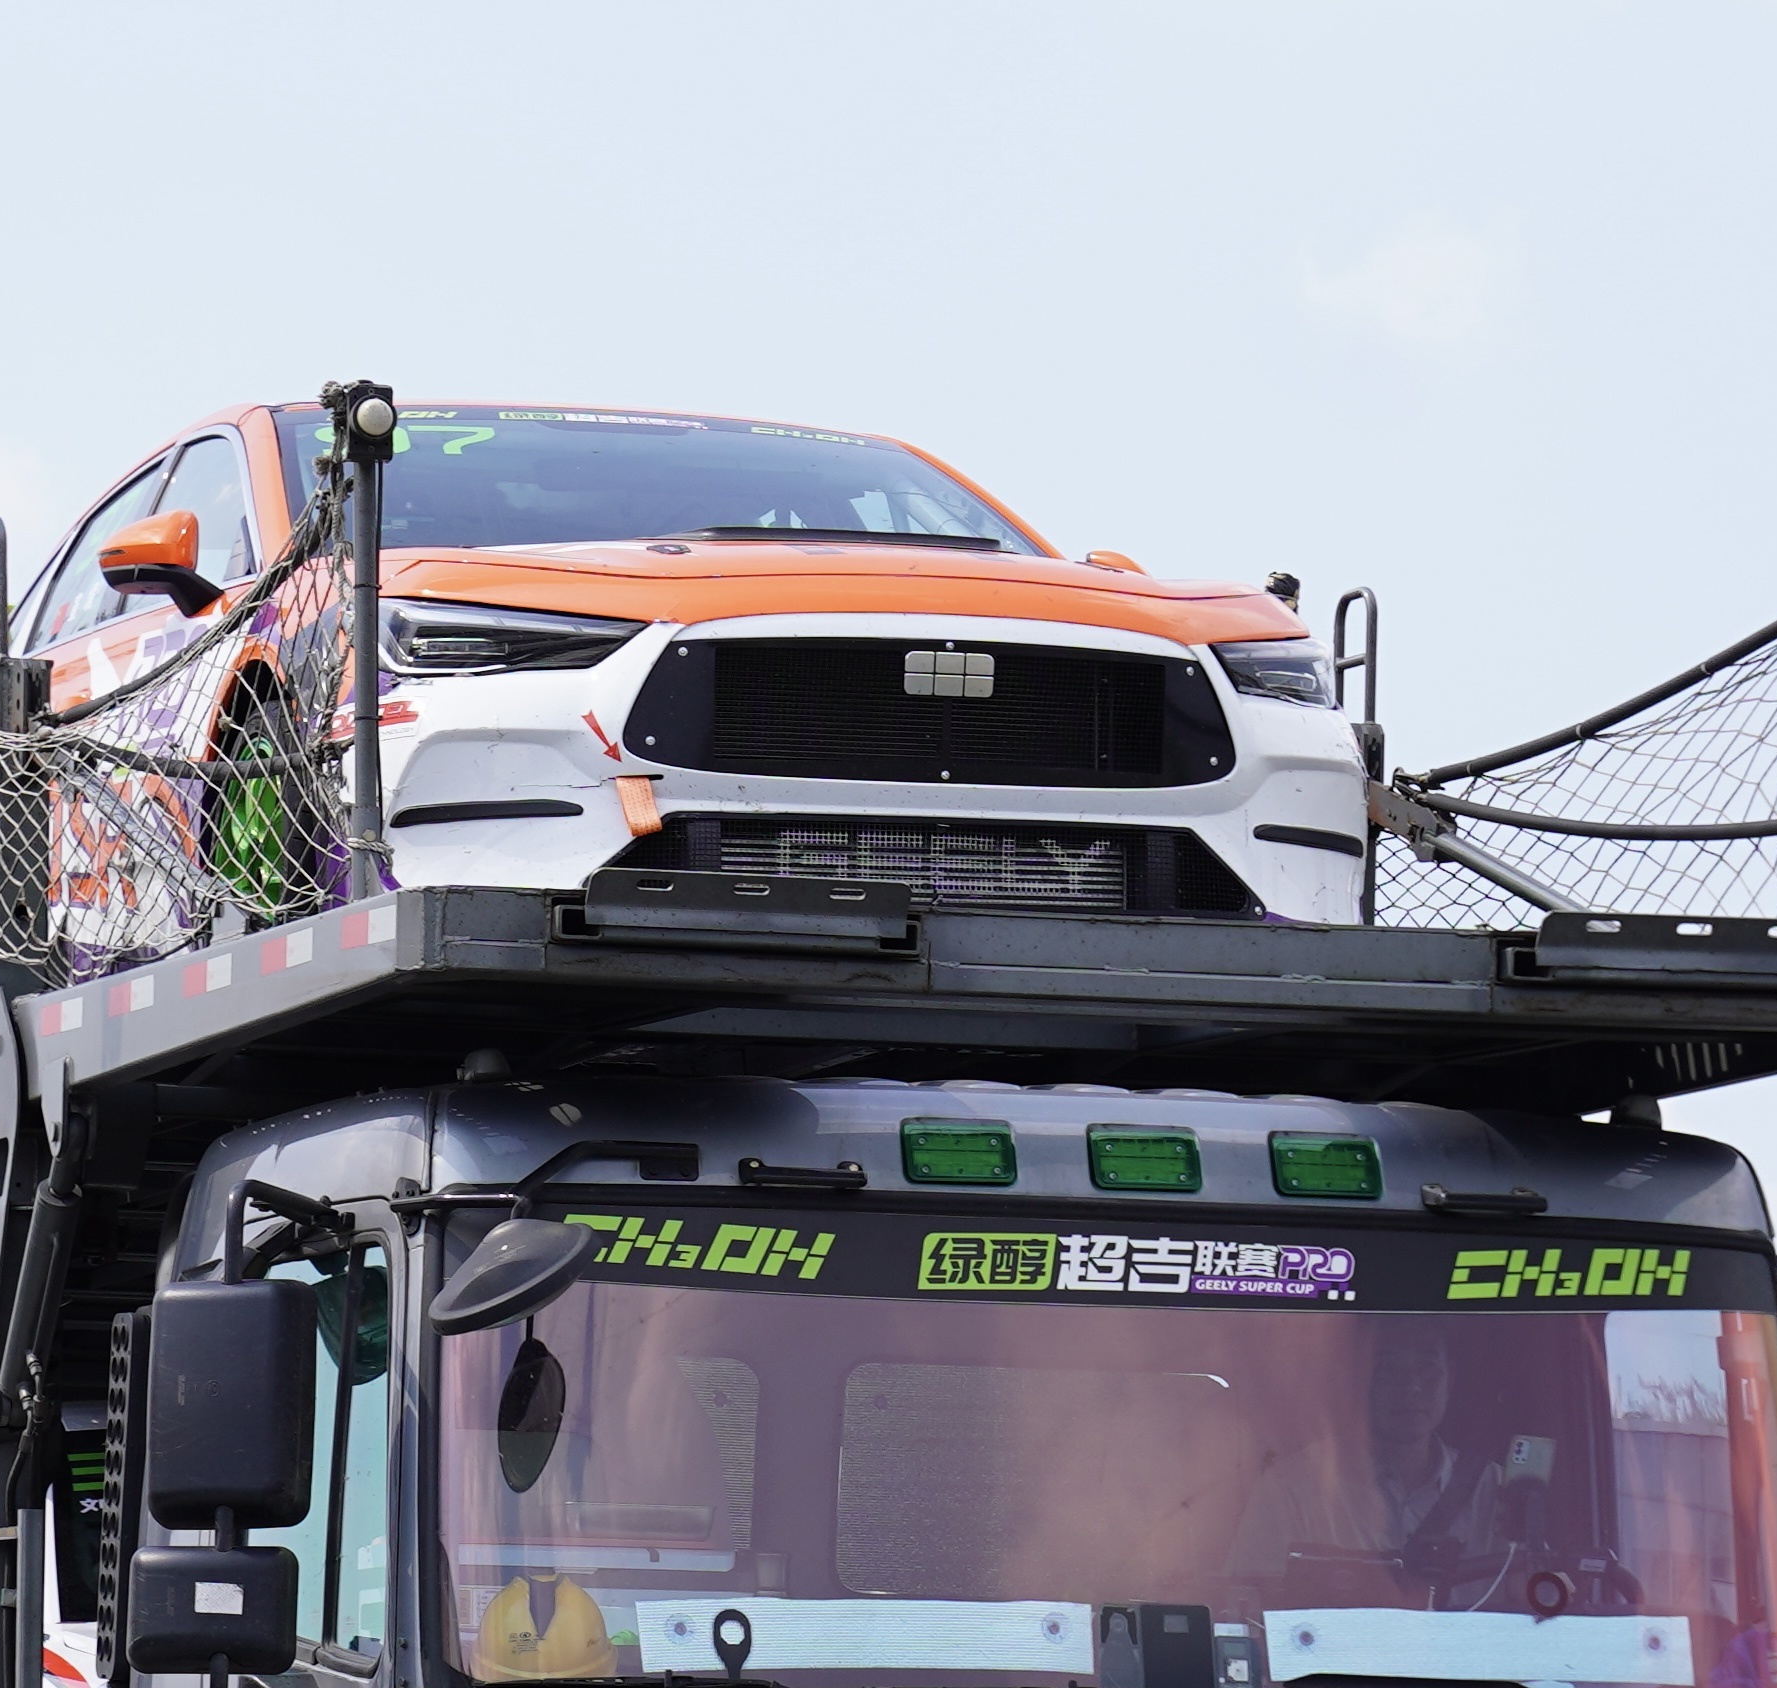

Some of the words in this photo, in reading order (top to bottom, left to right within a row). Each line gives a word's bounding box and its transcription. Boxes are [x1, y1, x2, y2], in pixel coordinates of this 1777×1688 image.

[778, 828, 1113, 896] GEELY
[1194, 1278, 1237, 1292] GEELY
[1238, 1280, 1284, 1294] SUPER
[1285, 1282, 1315, 1295] CUP
